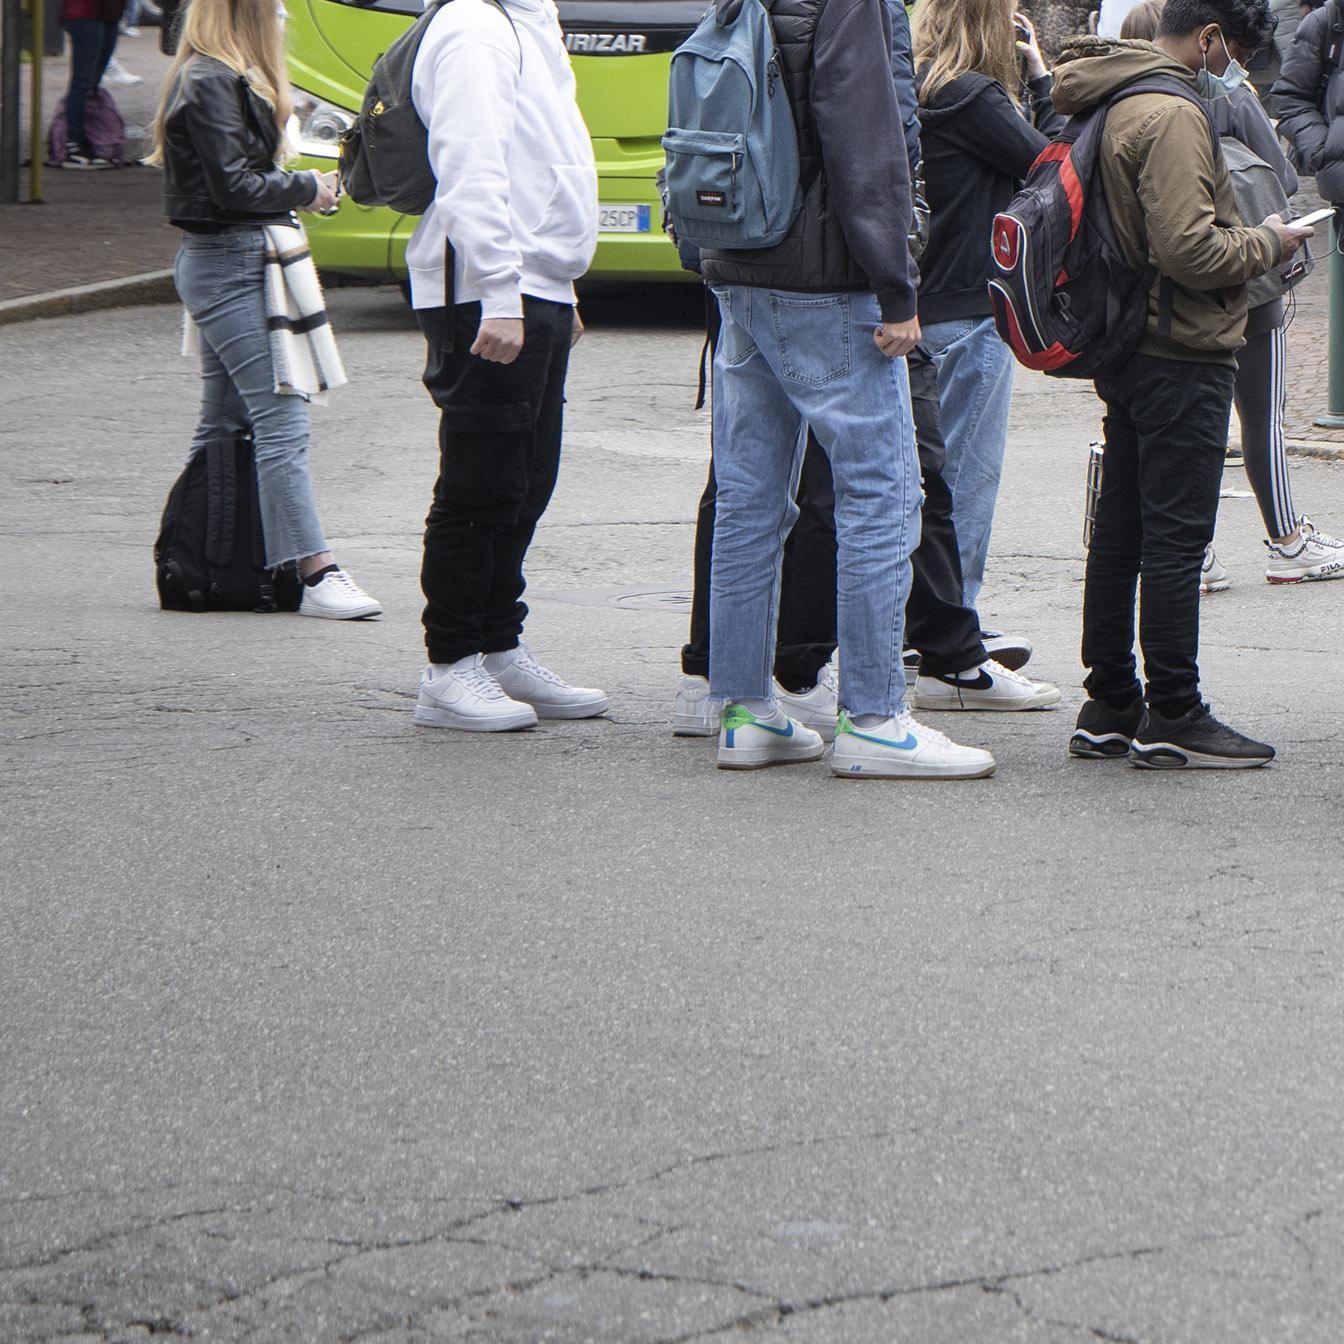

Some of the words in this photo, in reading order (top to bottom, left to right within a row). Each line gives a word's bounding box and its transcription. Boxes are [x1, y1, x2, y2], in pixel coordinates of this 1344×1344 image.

[565, 33, 648, 52] IRIZAR
[600, 209, 636, 228] 25CP
[1320, 562, 1341, 573] FILA
